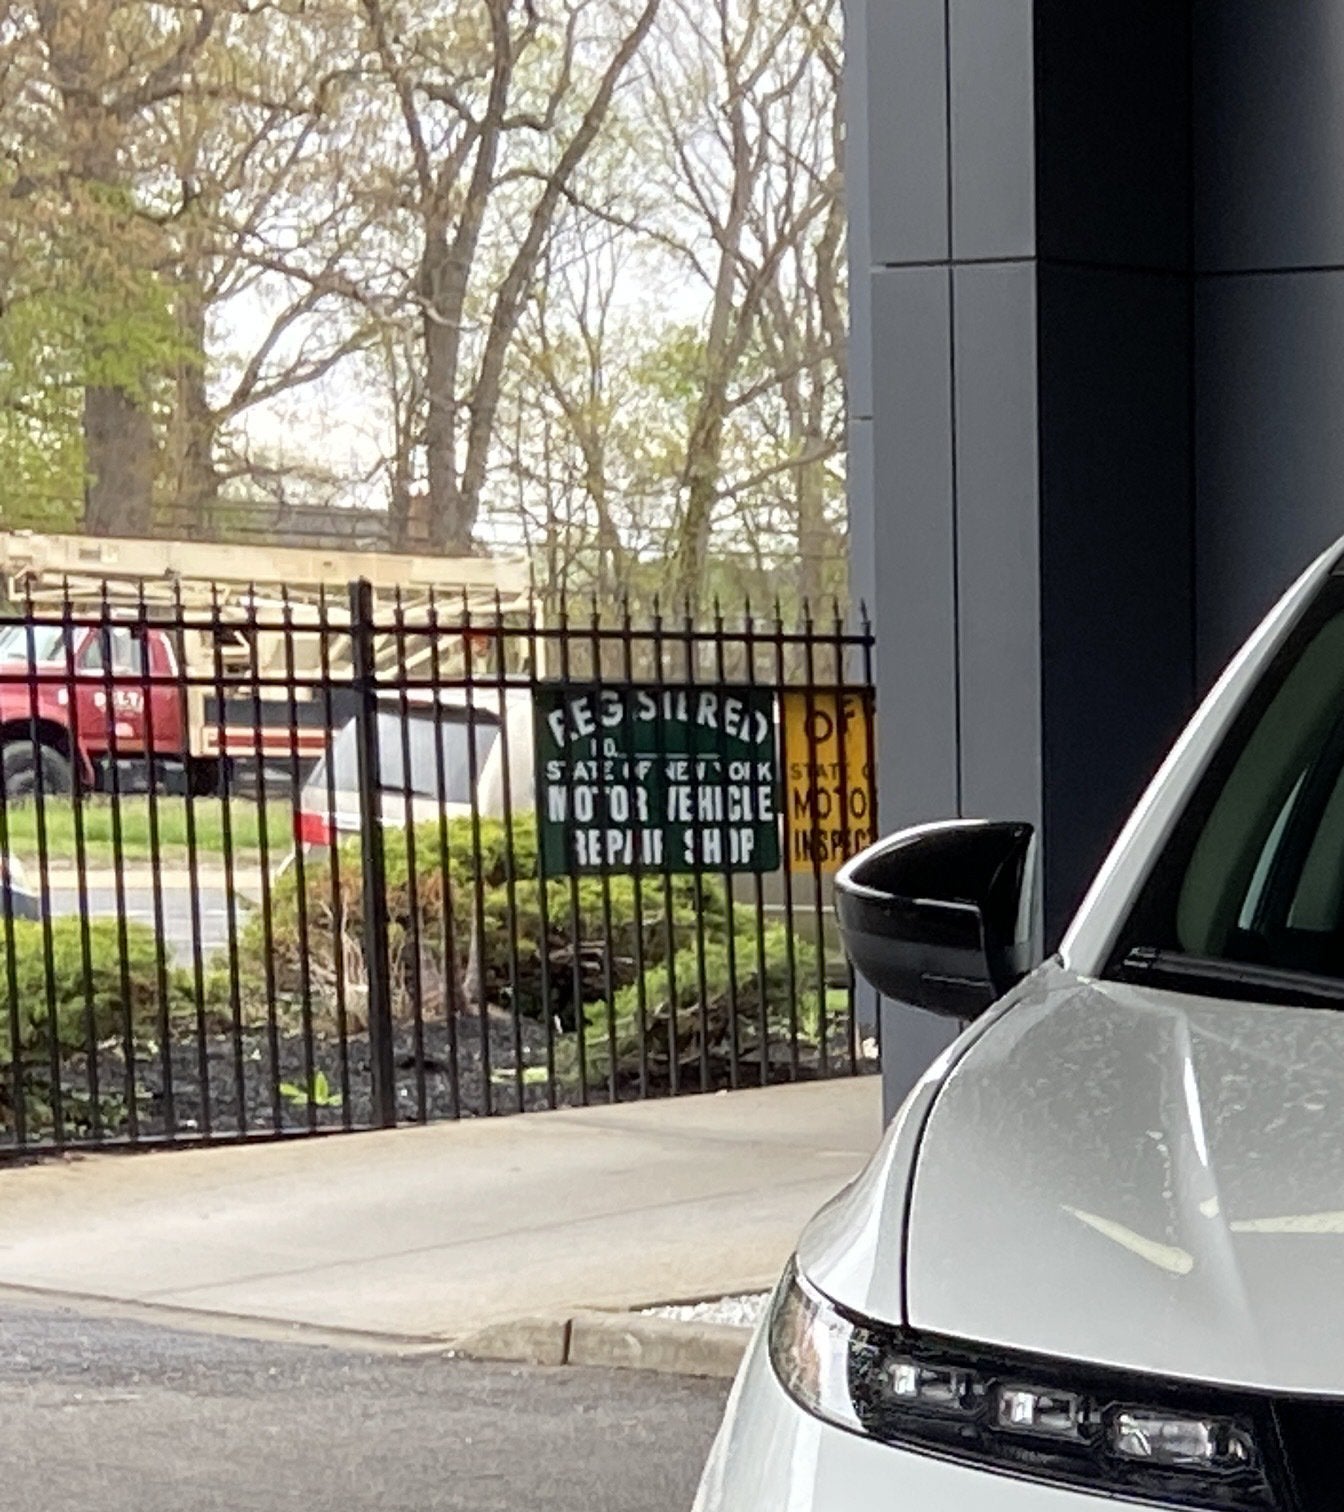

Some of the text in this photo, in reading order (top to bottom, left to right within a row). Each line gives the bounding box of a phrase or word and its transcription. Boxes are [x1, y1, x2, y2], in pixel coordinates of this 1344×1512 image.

[548, 688, 768, 748] REGSTERED
[547, 760, 615, 780] SATE
[712, 760, 773, 781] OK
[790, 763, 851, 780] STAT
[548, 785, 649, 822] MOOR
